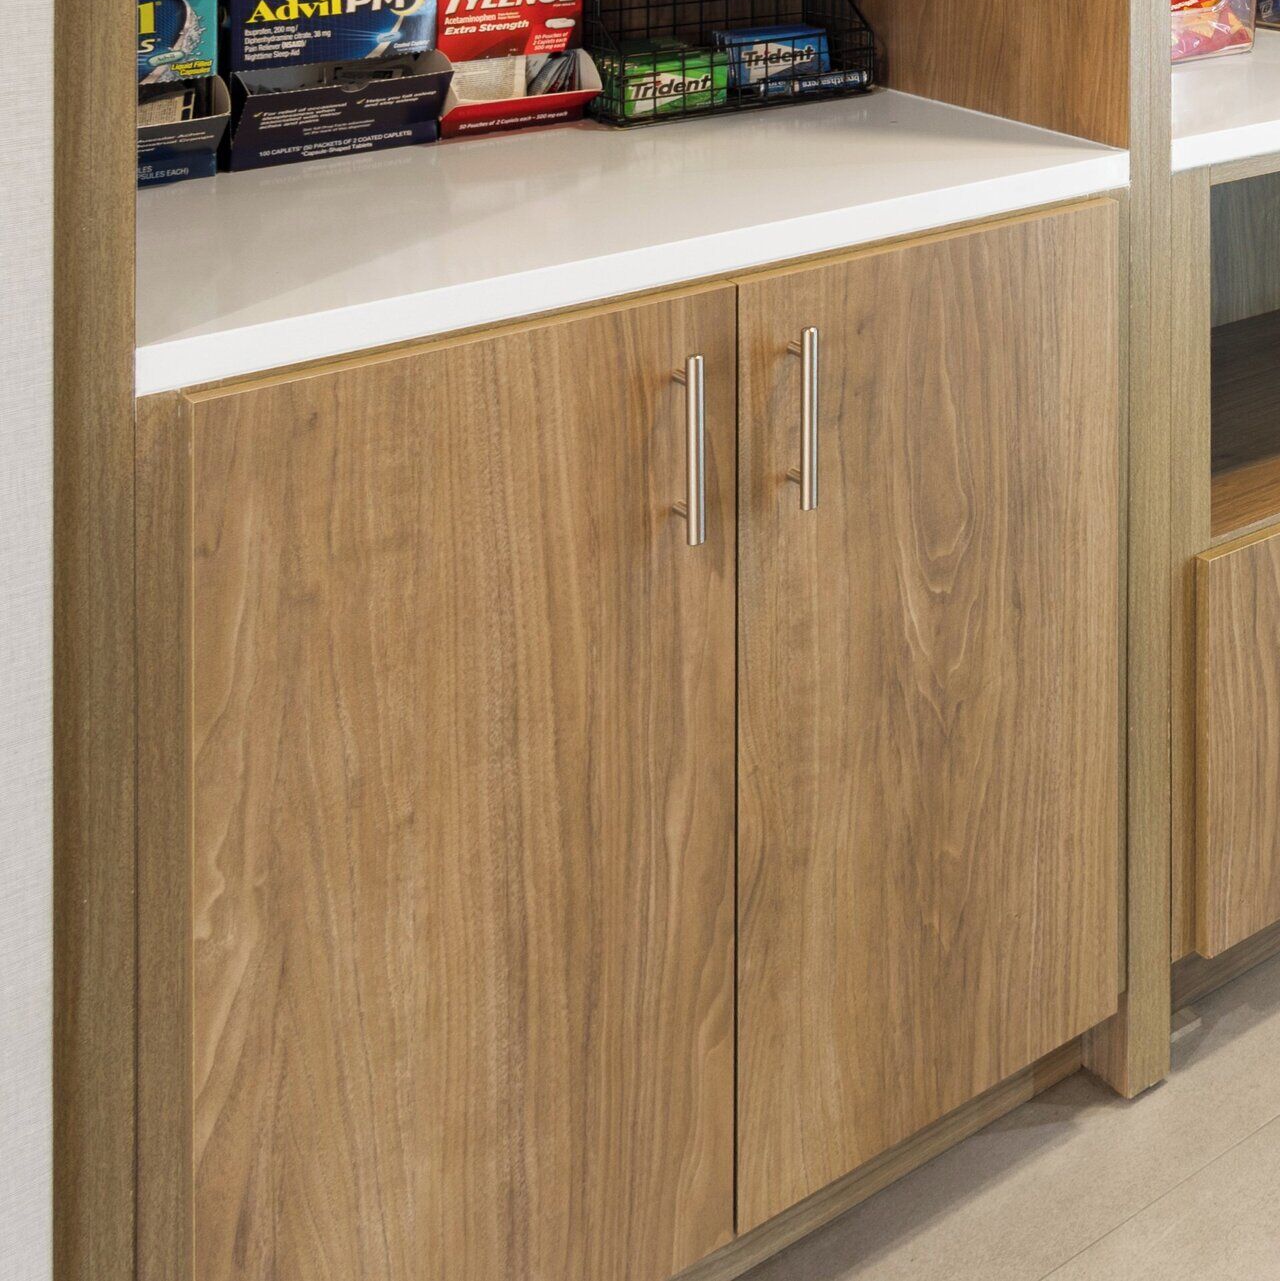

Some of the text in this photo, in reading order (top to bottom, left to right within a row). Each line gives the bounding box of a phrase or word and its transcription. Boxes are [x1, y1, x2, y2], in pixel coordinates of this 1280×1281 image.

[444, 13, 497, 26] Acetaminophen
[444, 19, 530, 36] Extra Strength
[244, 51, 272, 62] Nighttime
[743, 45, 815, 68] Trident
[631, 74, 712, 101] Trident
[313, 139, 343, 150] PACKETS
[358, 133, 384, 143] COATED
[384, 129, 413, 140] CAPLETS)
[352, 142, 373, 150] Tablets
